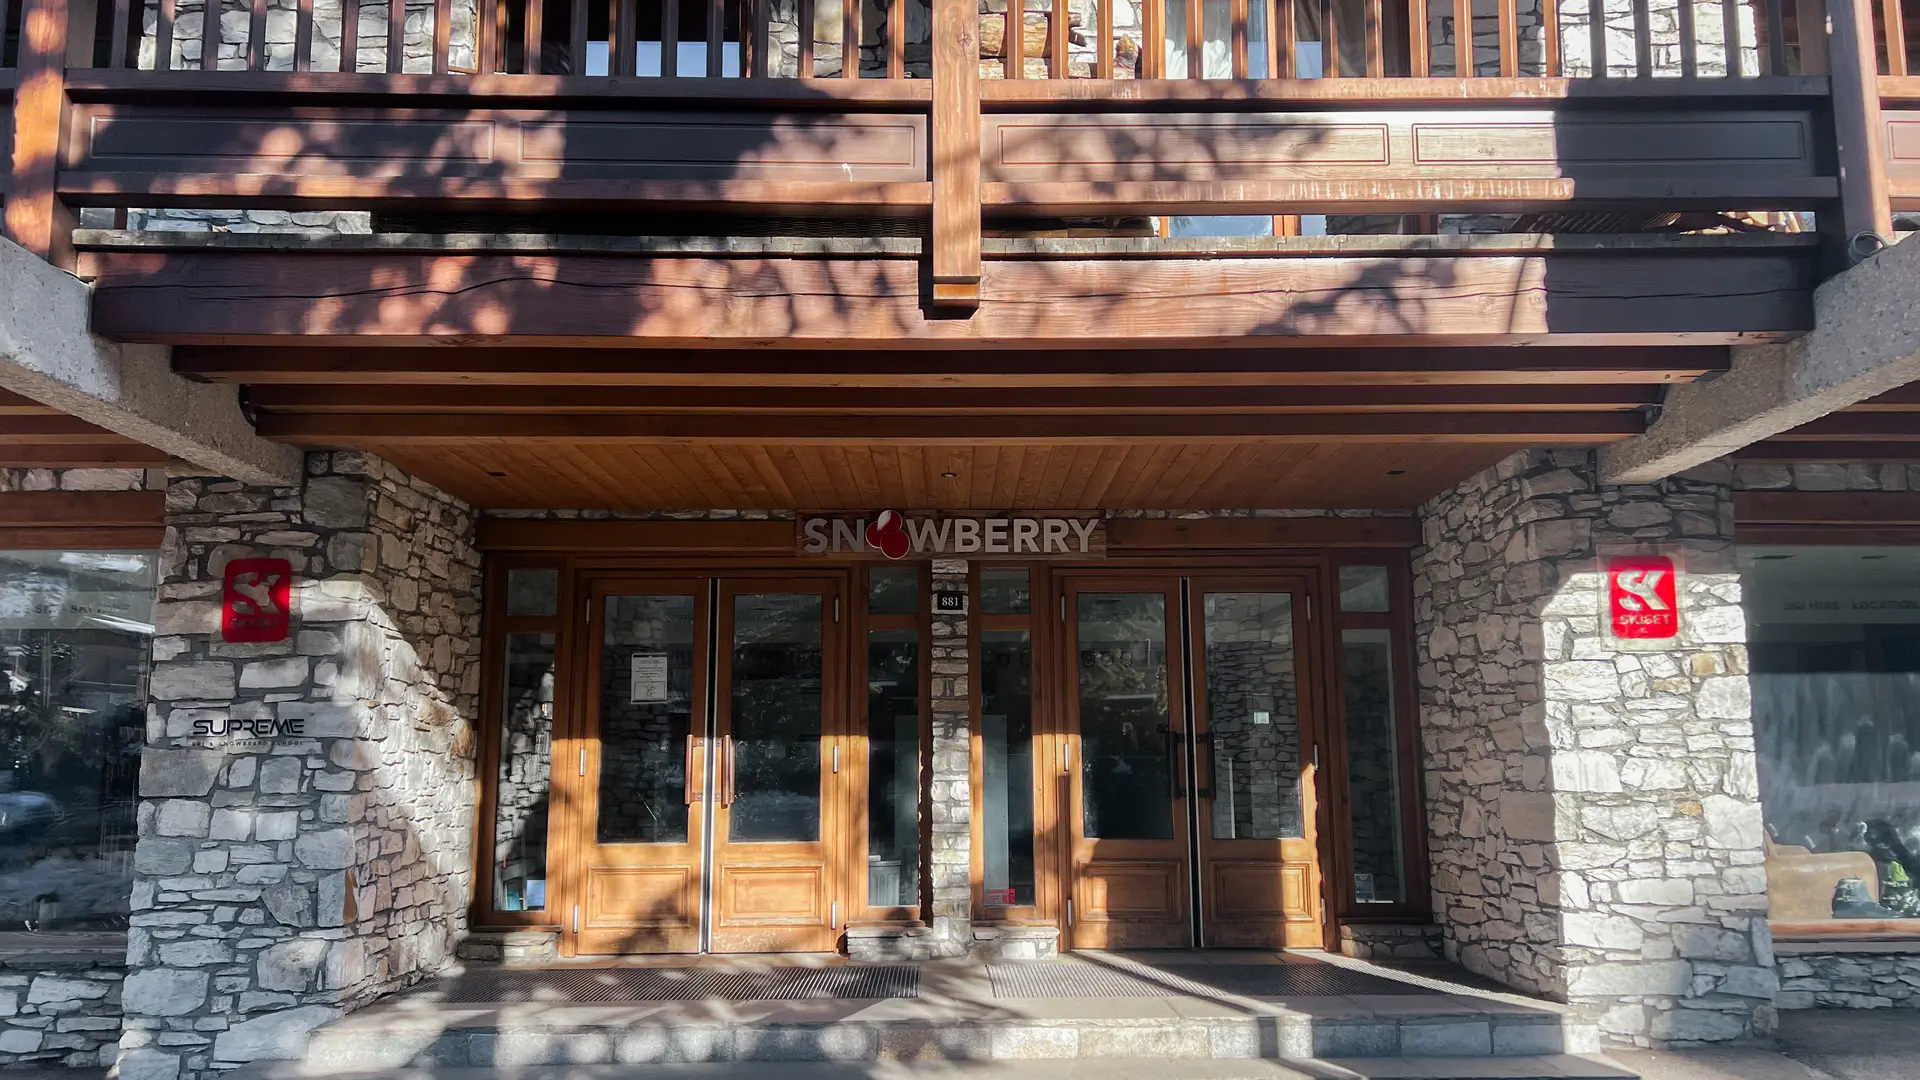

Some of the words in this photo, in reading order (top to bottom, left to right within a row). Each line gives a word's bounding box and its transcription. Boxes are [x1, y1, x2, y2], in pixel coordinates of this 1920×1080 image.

[941, 596, 959, 607] 881
[1619, 613, 1672, 625] SKISET
[192, 718, 305, 738] SUPREME
